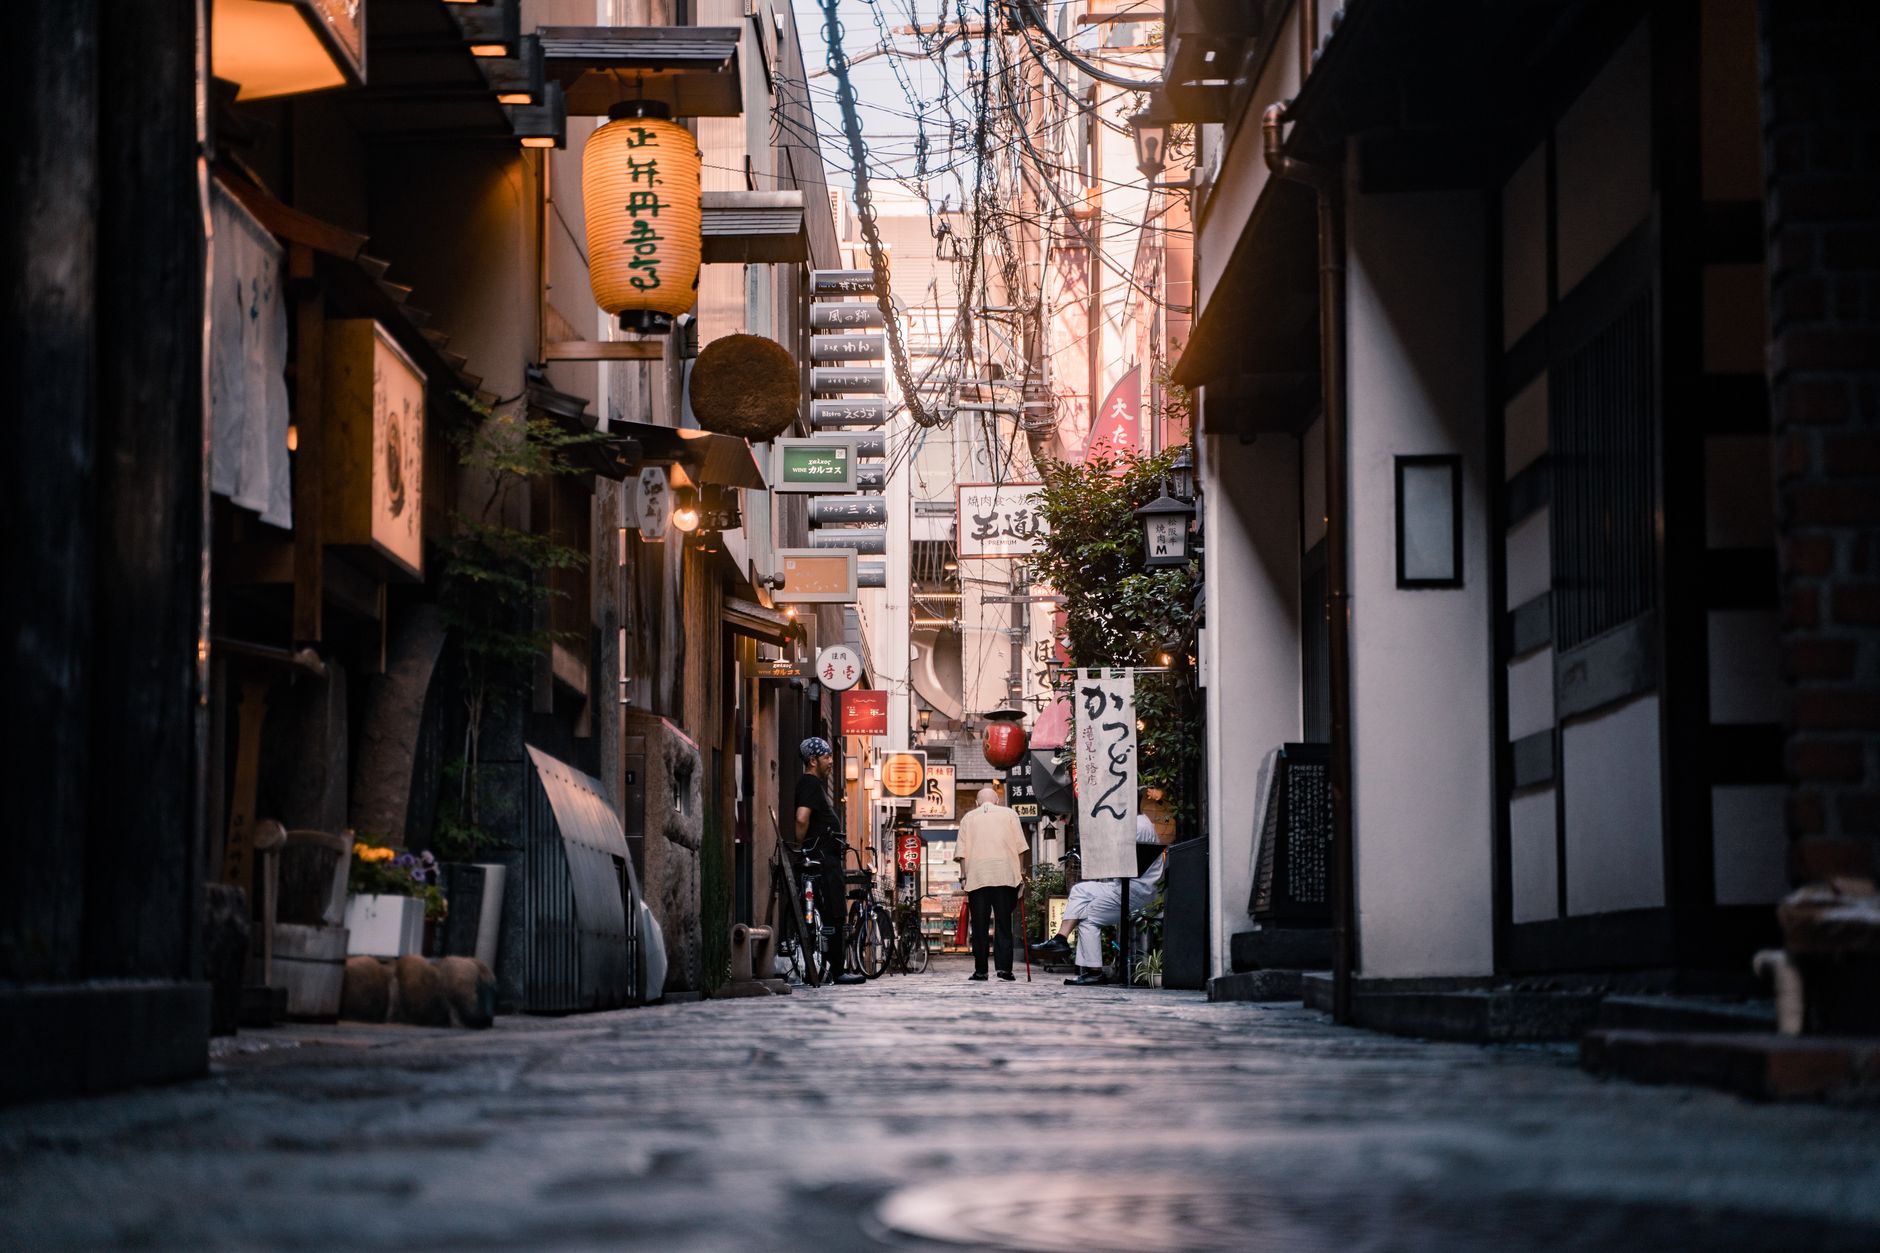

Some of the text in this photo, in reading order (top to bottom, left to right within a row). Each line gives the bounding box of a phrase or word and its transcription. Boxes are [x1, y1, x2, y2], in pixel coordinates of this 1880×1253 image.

[808, 466, 842, 474] カルコス
[1081, 684, 1135, 820] かつどん
